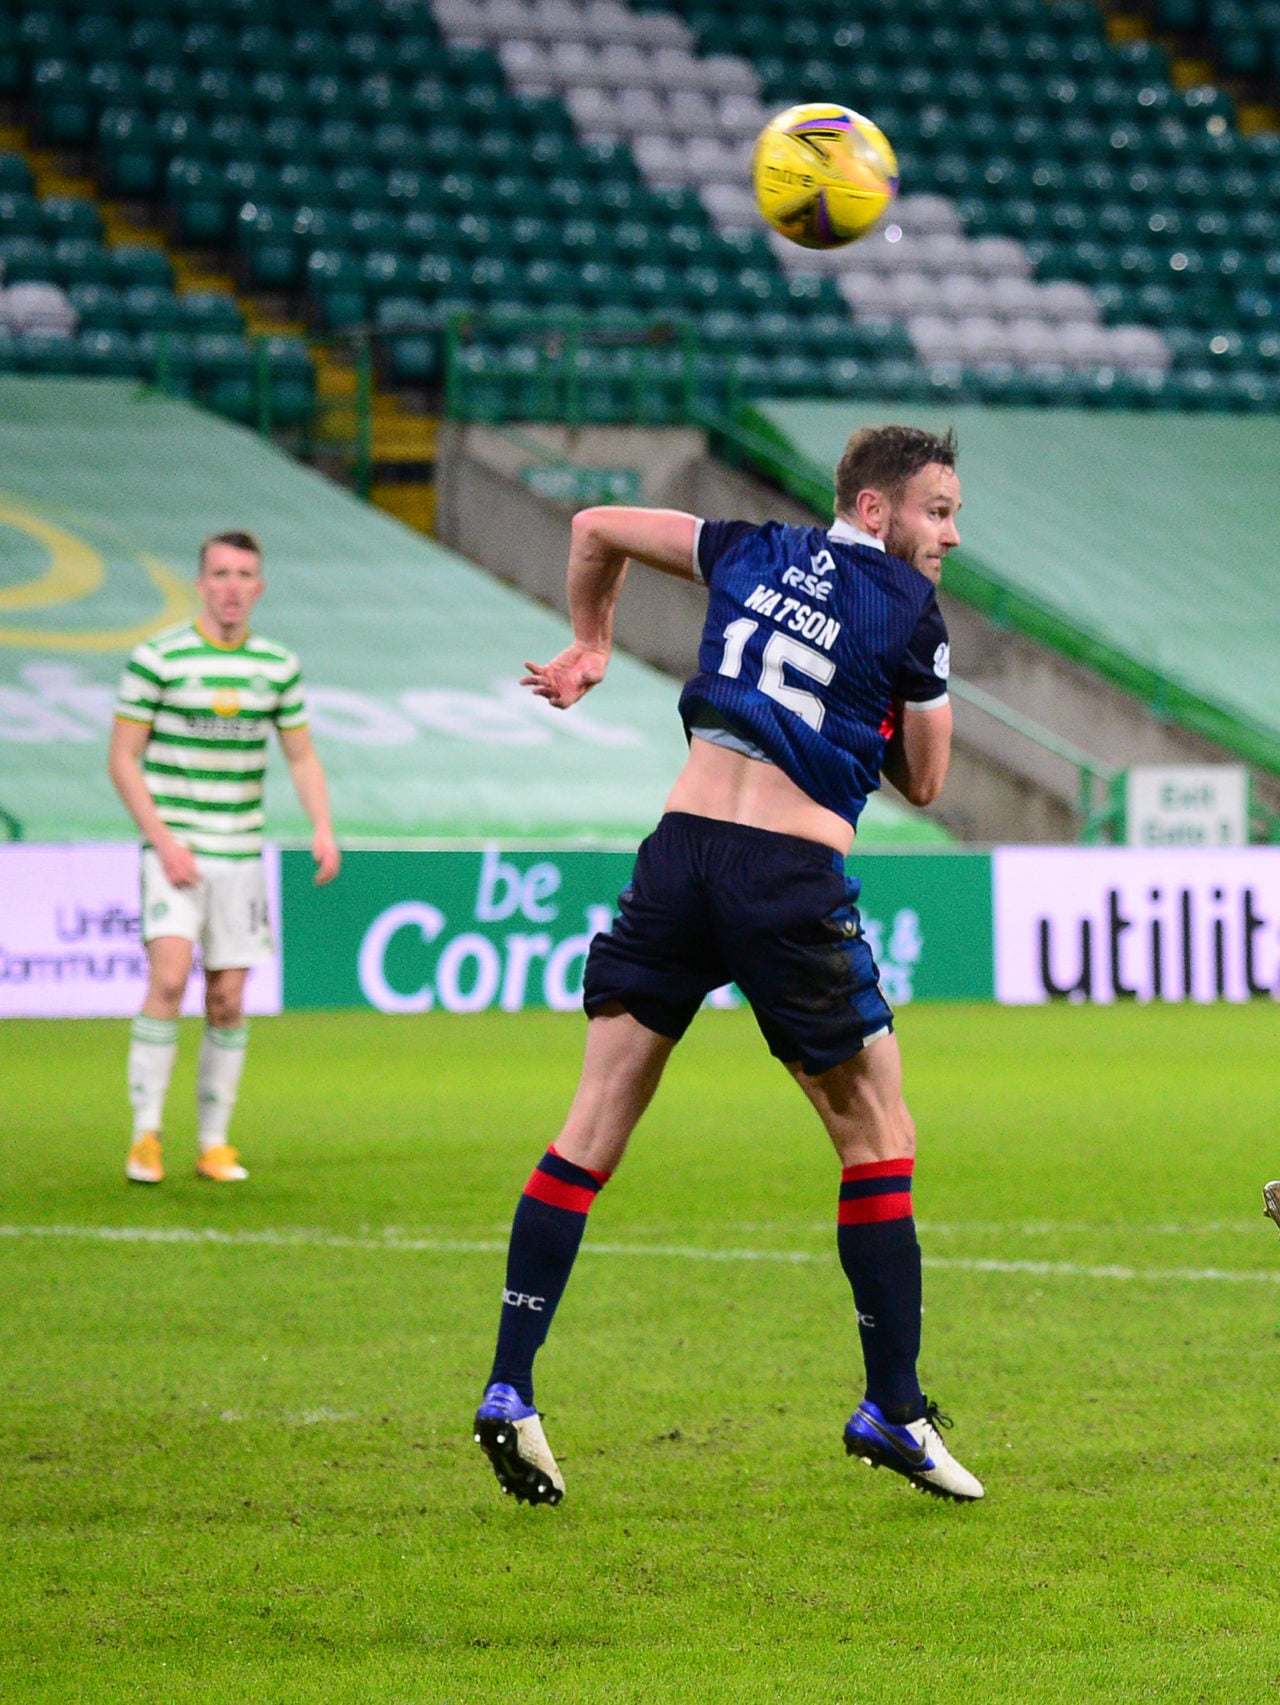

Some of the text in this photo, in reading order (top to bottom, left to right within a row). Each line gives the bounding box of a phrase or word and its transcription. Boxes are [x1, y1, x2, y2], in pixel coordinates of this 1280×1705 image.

[744, 584, 841, 650] WATSON
[782, 566, 833, 601] RSE
[718, 617, 837, 734] 15
[476, 842, 561, 921] be
[357, 900, 613, 1014] Cord
